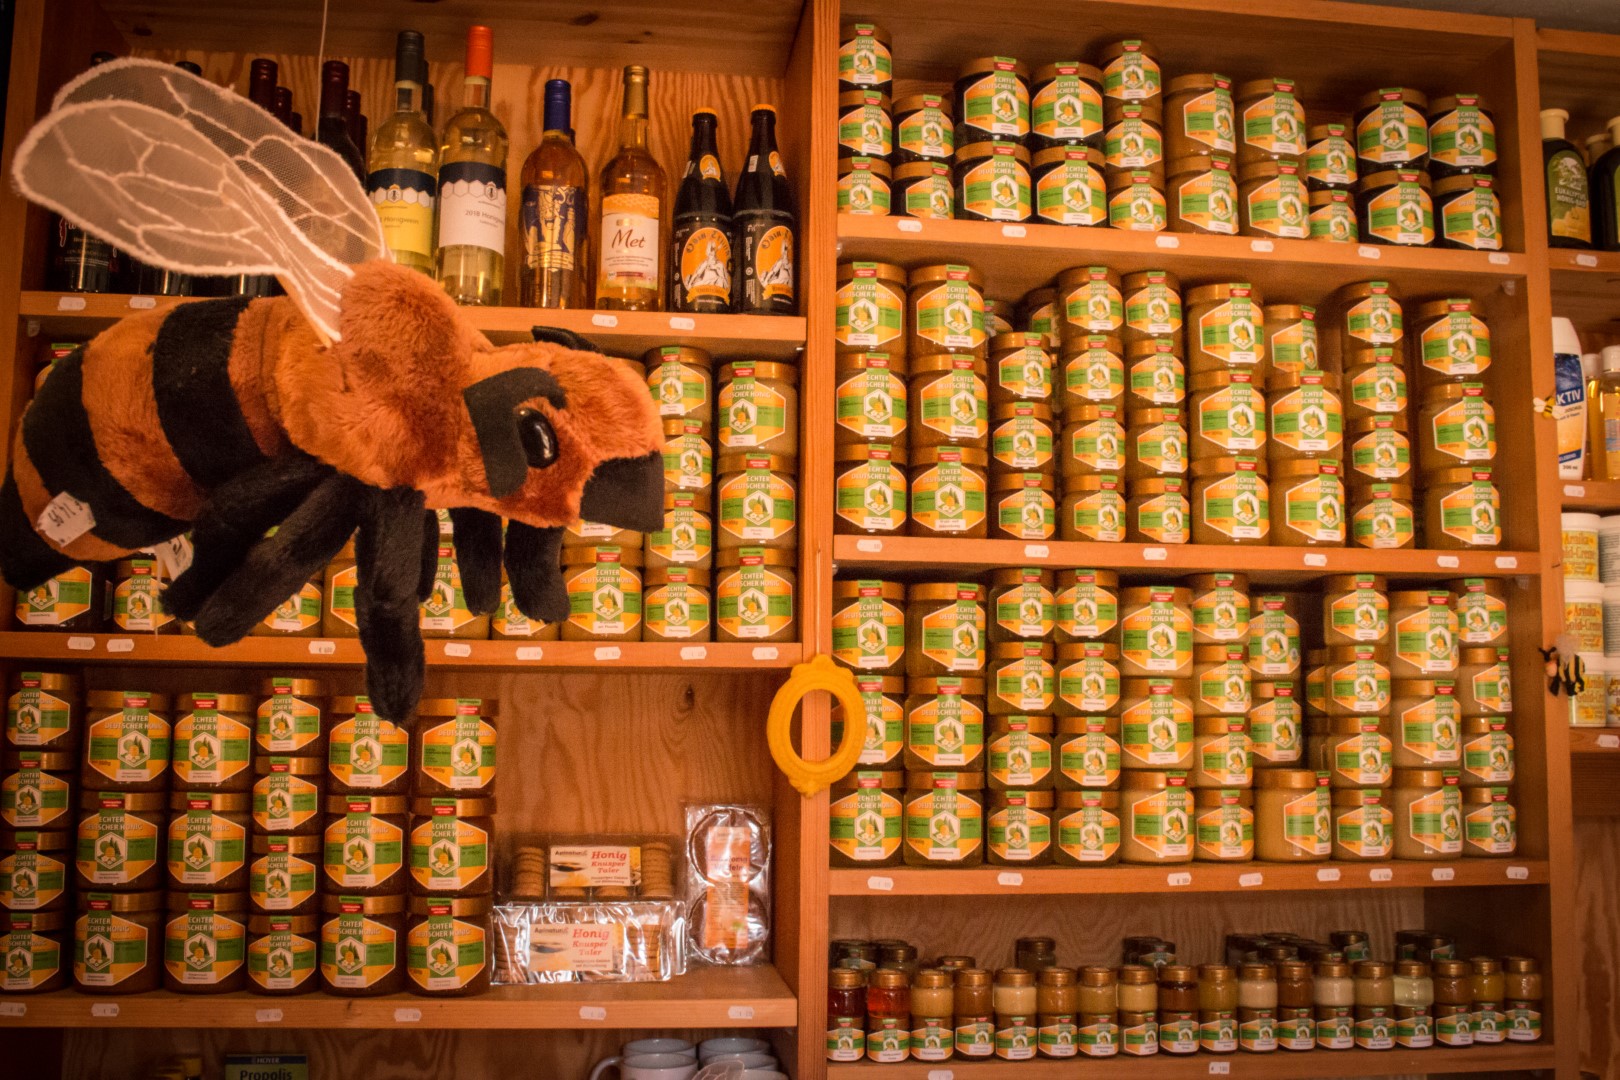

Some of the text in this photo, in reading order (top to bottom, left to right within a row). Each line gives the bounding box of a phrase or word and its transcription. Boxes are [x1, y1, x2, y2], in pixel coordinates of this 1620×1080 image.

[612, 228, 645, 248] Met
[591, 851, 626, 860] Honig
[572, 929, 609, 940] Honig
[240, 1068, 292, 1080] Propolis
